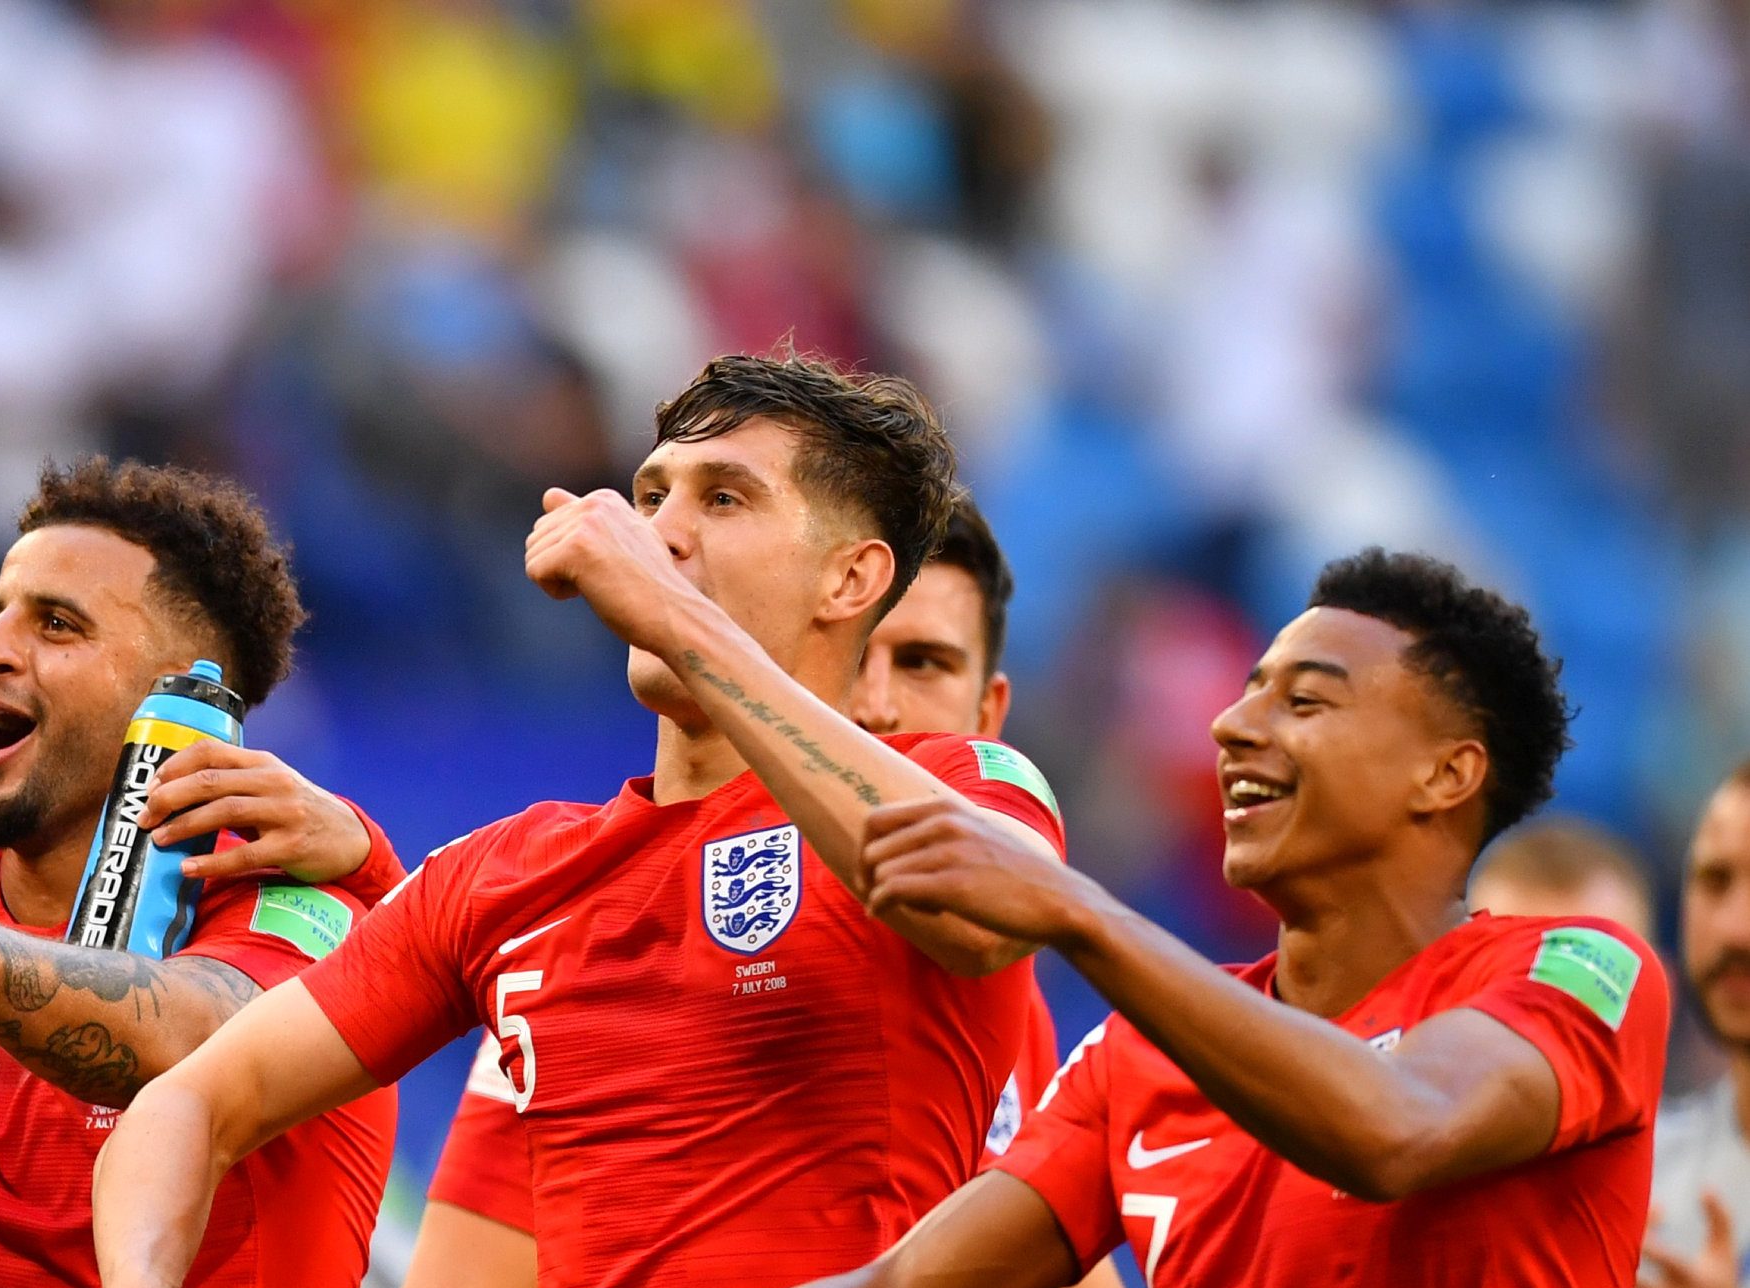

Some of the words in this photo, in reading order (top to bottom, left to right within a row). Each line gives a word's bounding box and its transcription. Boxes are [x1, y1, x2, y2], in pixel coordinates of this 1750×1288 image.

[80, 744, 162, 947] POWERADE
[735, 960, 776, 978] SWEDEN
[731, 983, 740, 996] 7
[741, 980, 763, 995] JULY
[764, 976, 787, 992] 2018
[496, 969, 544, 1114] 5
[85, 1116, 93, 1130] 7
[93, 1116, 115, 1129] JULY
